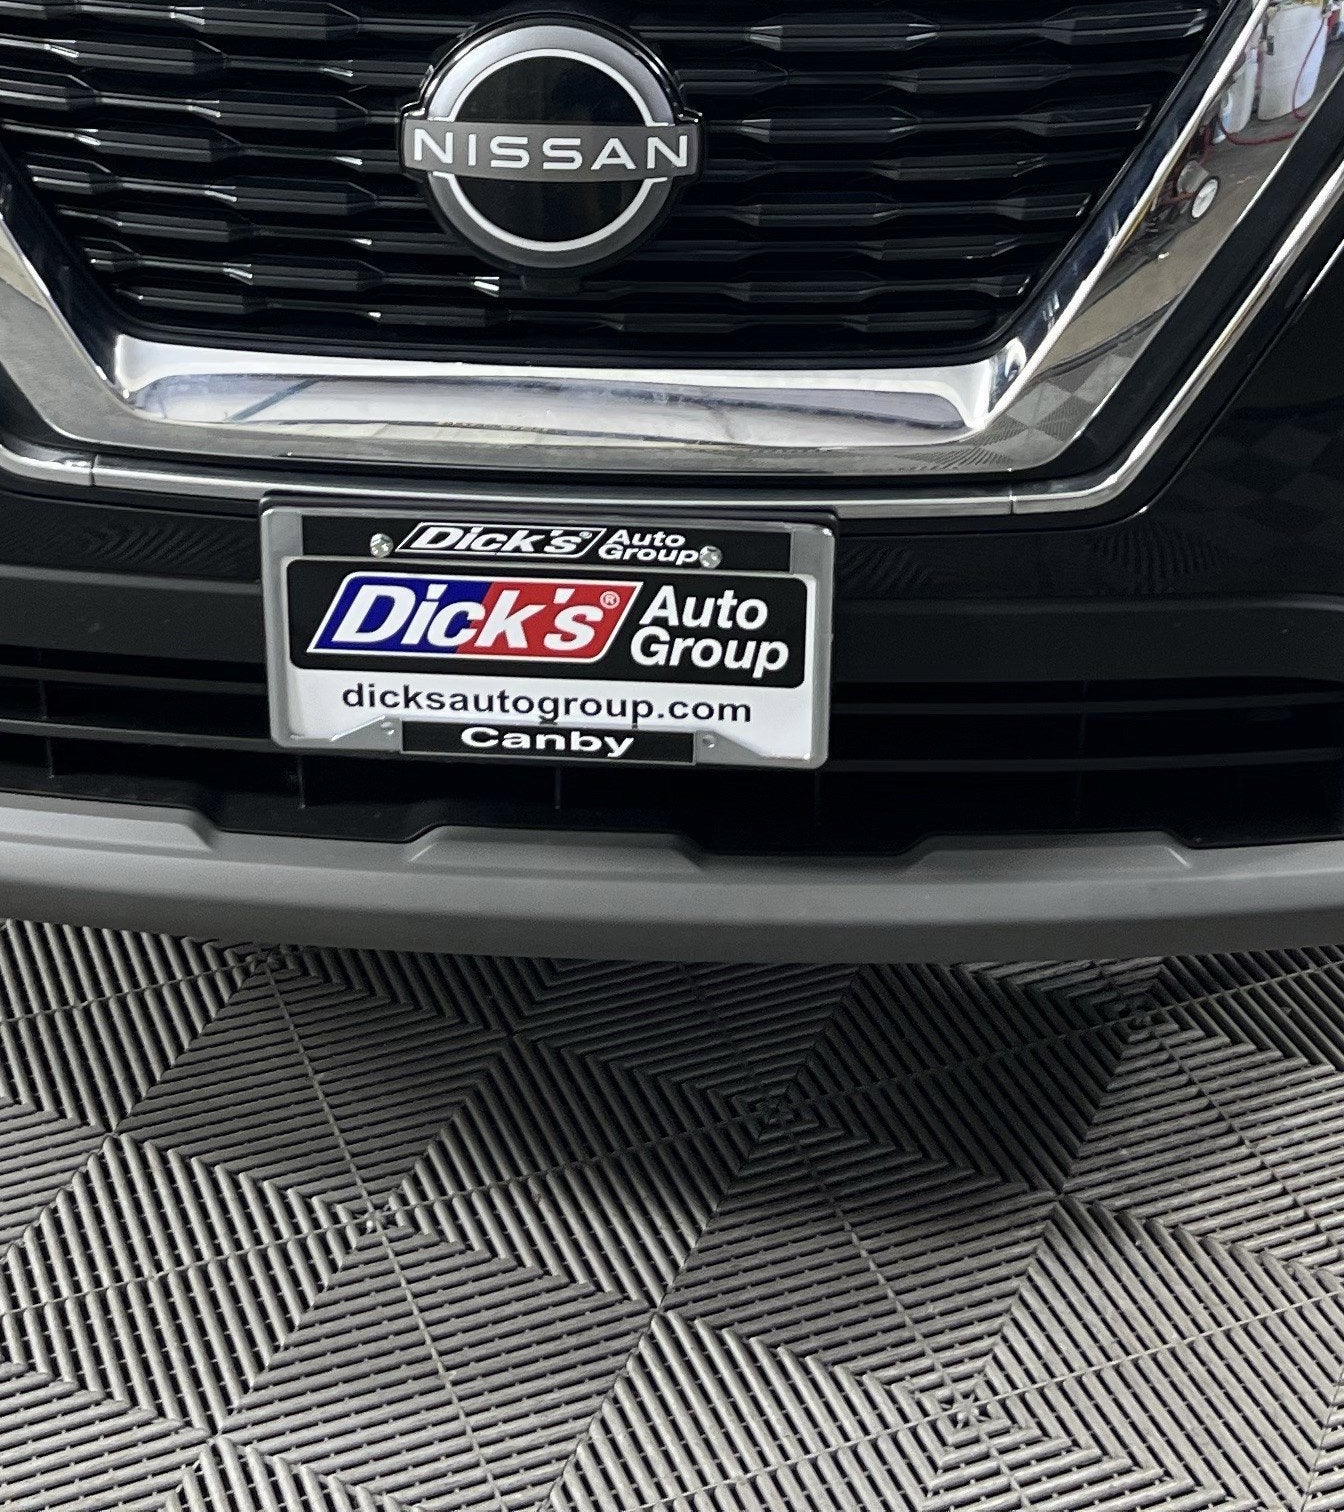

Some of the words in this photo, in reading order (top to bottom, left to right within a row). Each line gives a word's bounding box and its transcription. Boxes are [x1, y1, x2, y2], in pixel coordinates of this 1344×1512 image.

[414, 128, 688, 170] NISSAN
[599, 543, 699, 565] Group
[607, 529, 686, 548] Auto
[644, 585, 768, 631] Auto
[630, 627, 790, 678] Group
[342, 683, 752, 728] dicksautogroup.com
[460, 726, 634, 758] Canby
